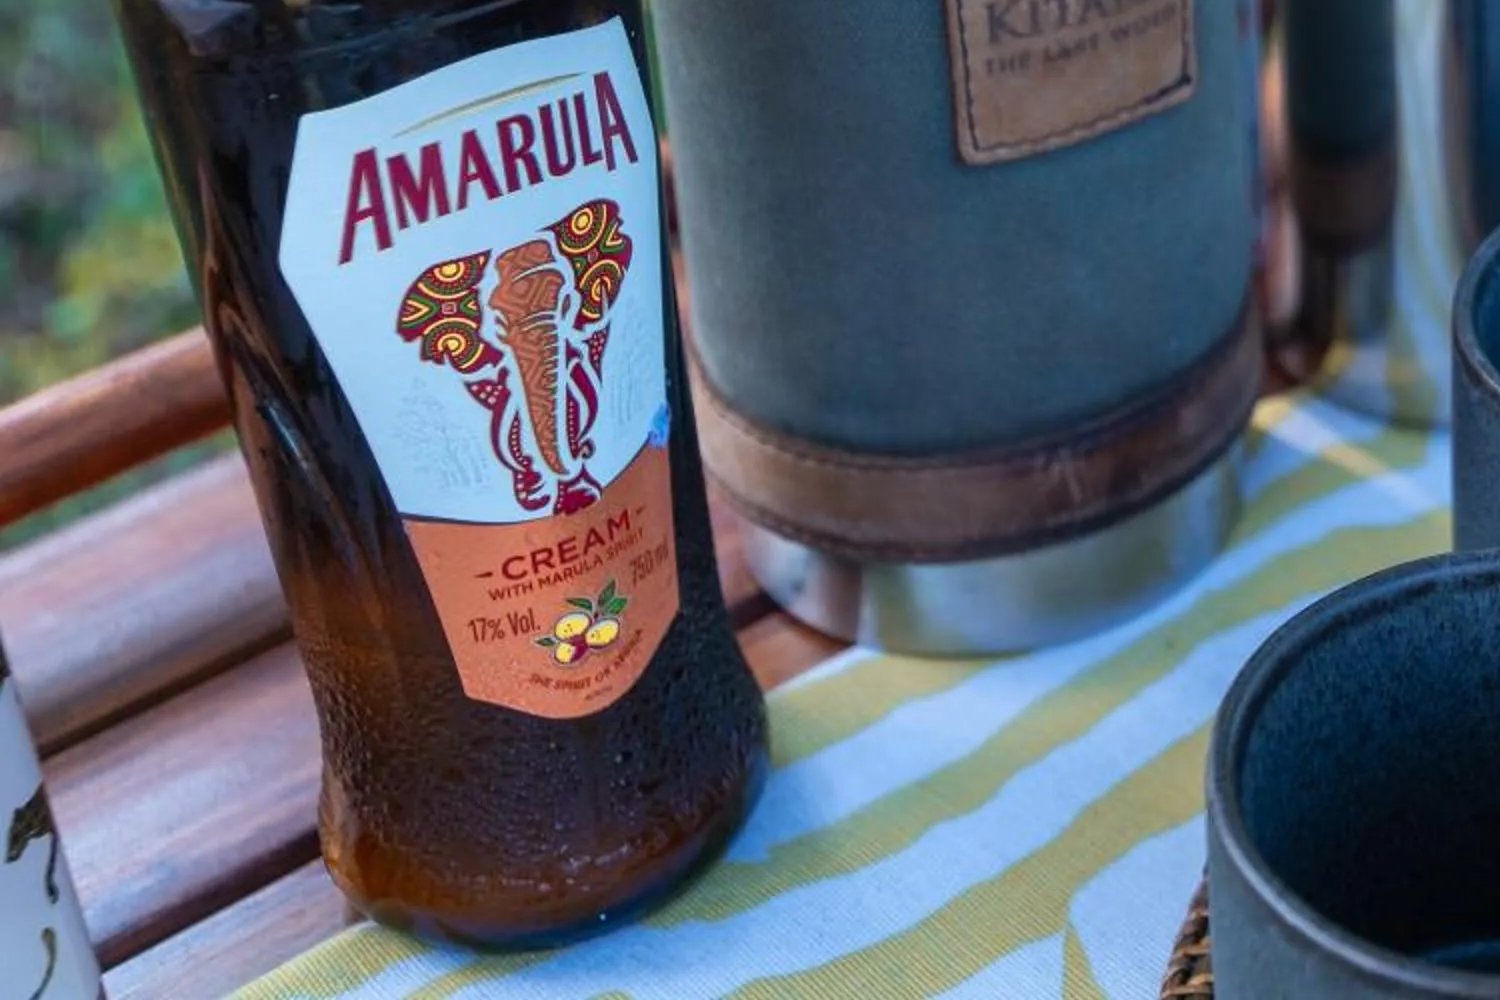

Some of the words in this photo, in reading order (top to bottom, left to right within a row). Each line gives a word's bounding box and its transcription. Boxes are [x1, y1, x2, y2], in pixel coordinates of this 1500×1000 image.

[338, 71, 639, 266] AMARULA
[501, 508, 630, 581] CREAM
[488, 580, 534, 601] WITH
[538, 554, 603, 590] MARULA
[466, 616, 506, 643] 17%
[506, 606, 541, 637] Vol.
